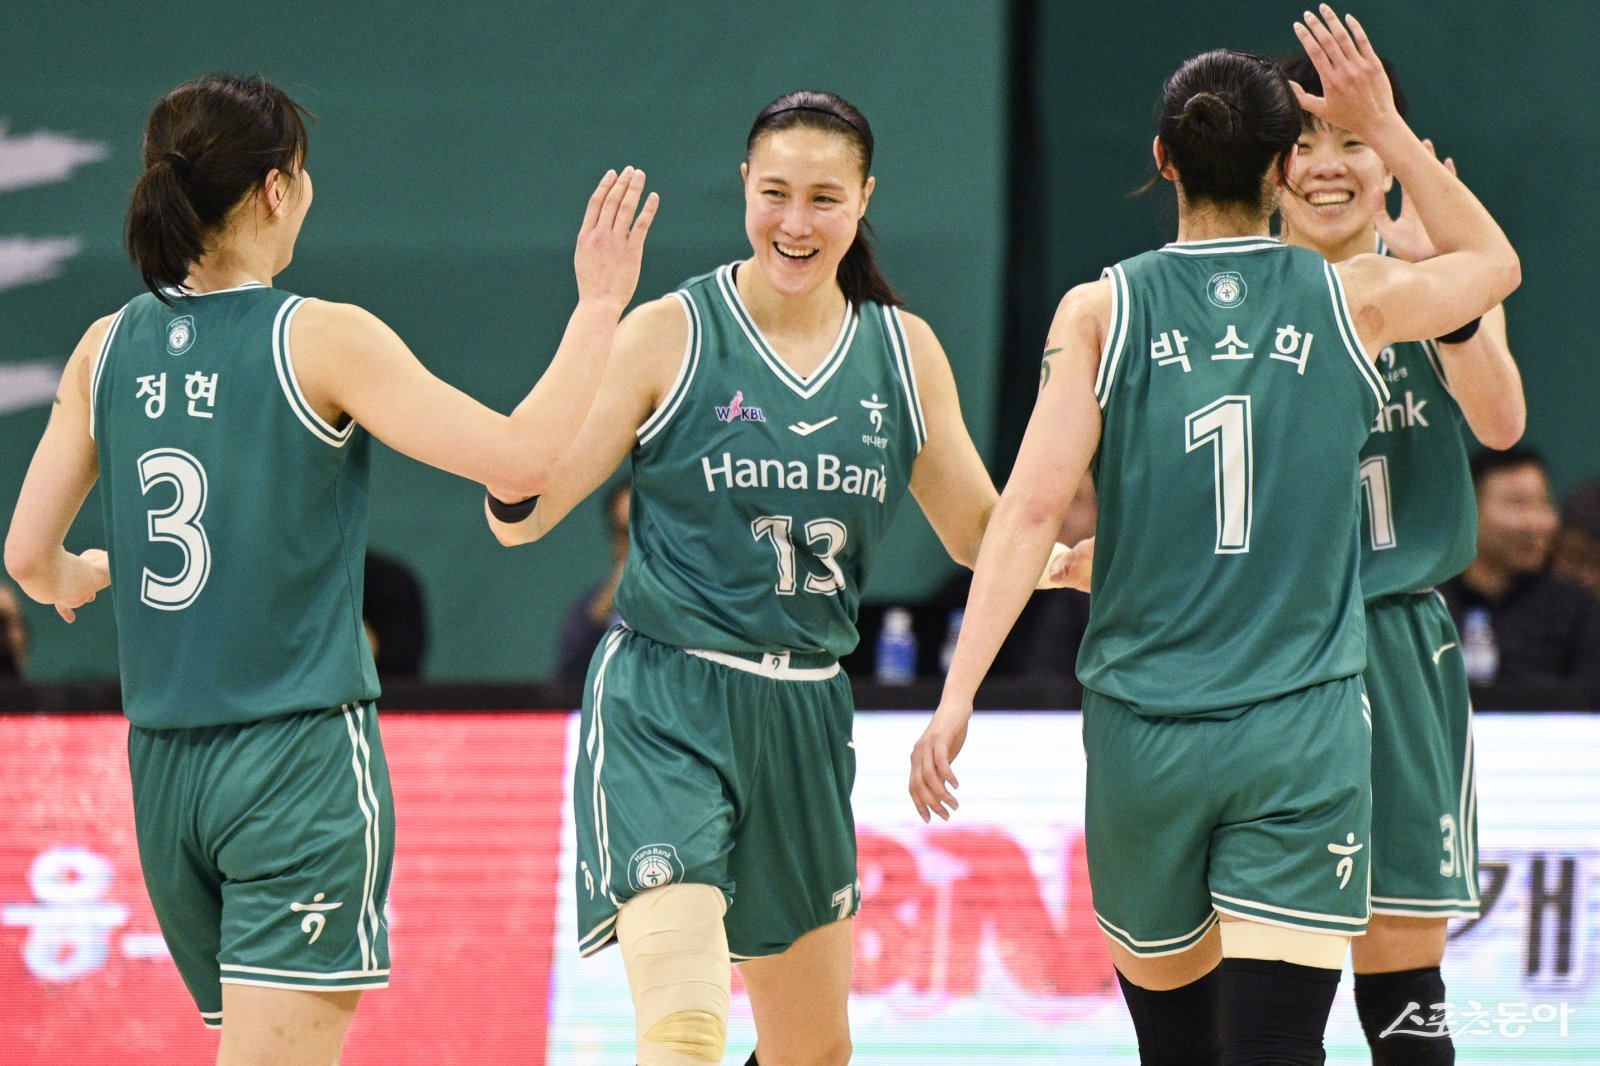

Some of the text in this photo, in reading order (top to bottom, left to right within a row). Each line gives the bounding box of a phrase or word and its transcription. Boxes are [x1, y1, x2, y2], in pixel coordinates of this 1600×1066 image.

[701, 452, 809, 492] Hana
[1185, 395, 1254, 555] 1
[136, 447, 212, 612] 3
[751, 515, 847, 596] 13
[634, 847, 672, 862] Hana Bank
